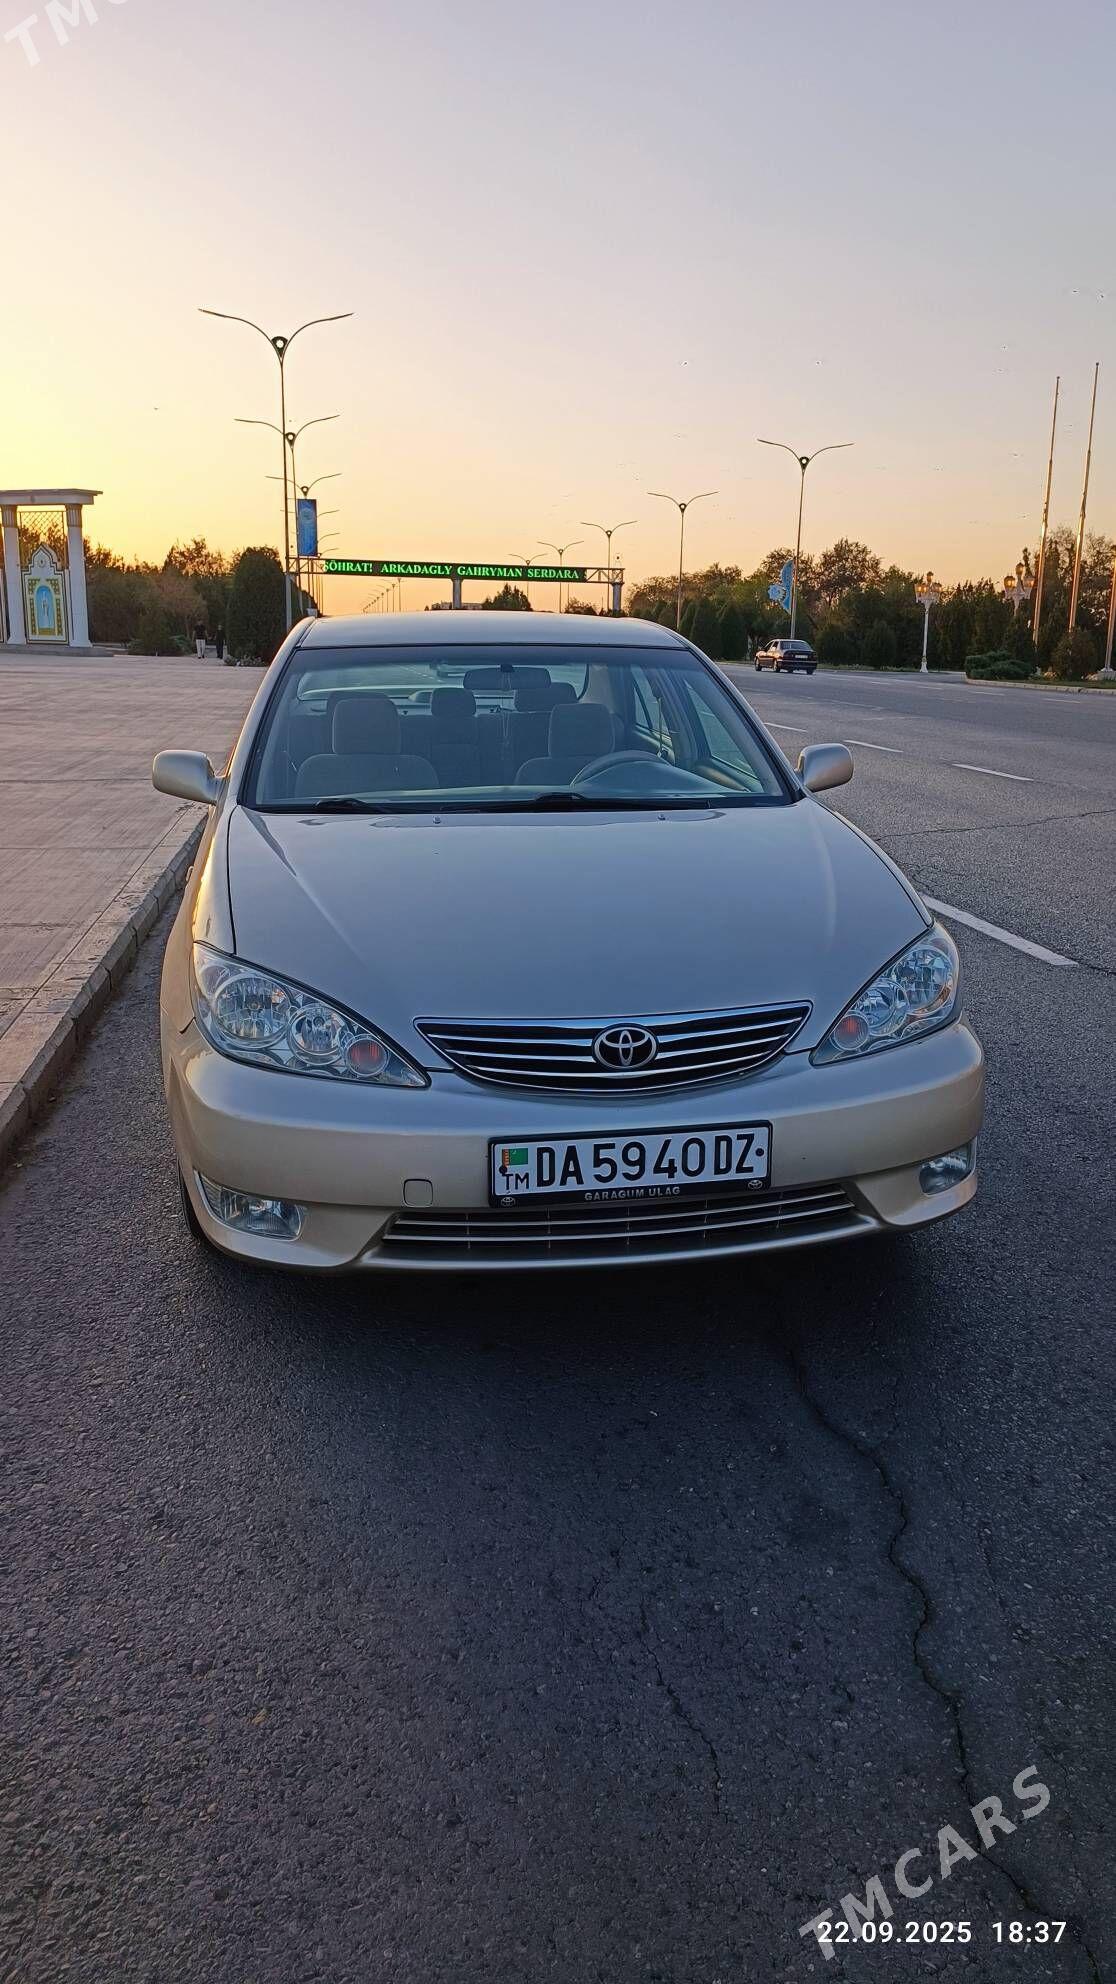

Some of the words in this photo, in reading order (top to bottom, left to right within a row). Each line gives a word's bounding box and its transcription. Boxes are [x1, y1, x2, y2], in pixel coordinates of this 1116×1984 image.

[381, 563, 453, 575] ARKADAGLY
[457, 566, 523, 577] GAHRYMAN
[527, 568, 579, 579] SERDARA
[503, 1172, 530, 1190] TM
[584, 1188, 645, 1201] GARAGUM
[648, 1186, 681, 1197] ULAG
